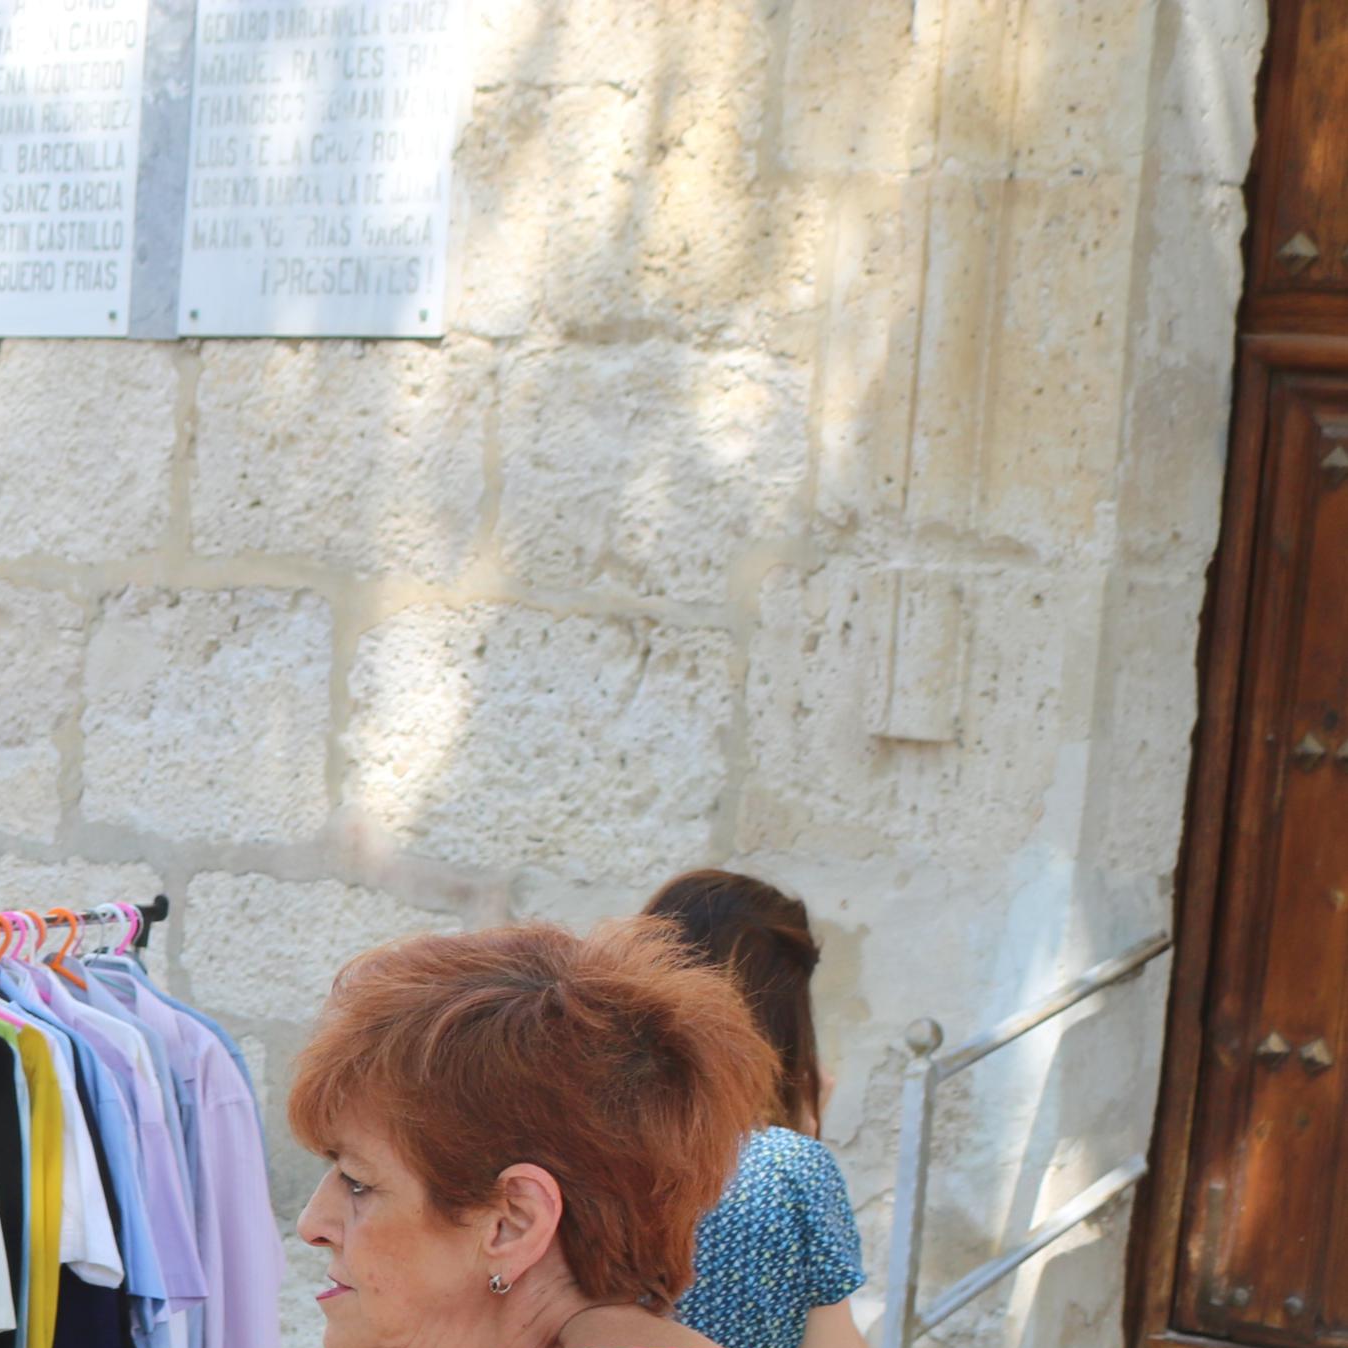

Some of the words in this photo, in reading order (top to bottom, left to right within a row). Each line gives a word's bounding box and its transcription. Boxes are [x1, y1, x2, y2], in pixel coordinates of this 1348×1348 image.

[69, 20, 138, 52] CAMPO
[34, 60, 125, 95] IZQUIERDO
[17, 140, 125, 174] BARCENILLA
[1, 183, 51, 213] SANZ
[36, 220, 124, 251] CASTRILLO
[62, 261, 118, 291] FRIAS
